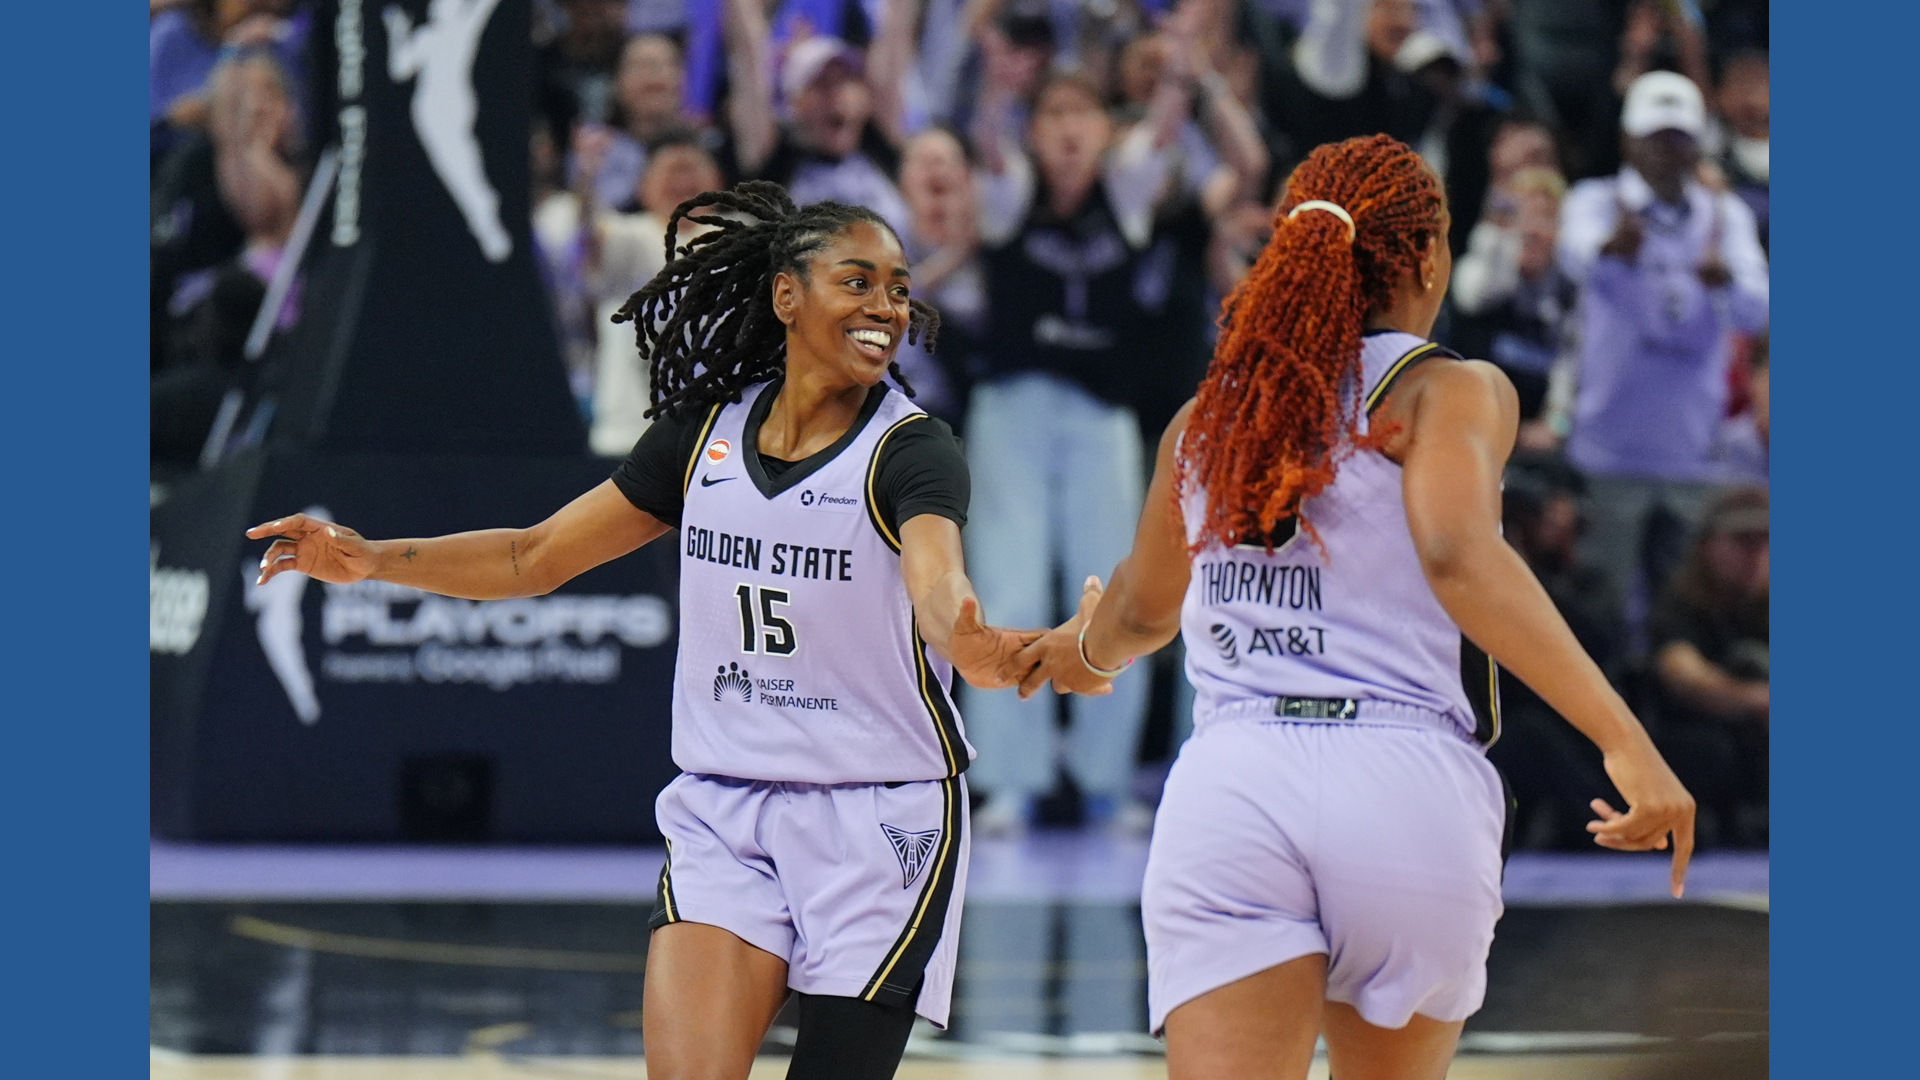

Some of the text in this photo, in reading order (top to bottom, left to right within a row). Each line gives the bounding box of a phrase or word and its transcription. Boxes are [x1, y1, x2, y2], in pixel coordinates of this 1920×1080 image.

[817, 492, 858, 506] freedom
[687, 525, 852, 581] GOLDEN STATE
[1200, 561, 1323, 612] THORNTON
[322, 596, 672, 648] PLAYOFFS
[733, 582, 798, 658] 15
[1248, 626, 1330, 656] AT&T
[760, 692, 839, 710] PERMANENTE
